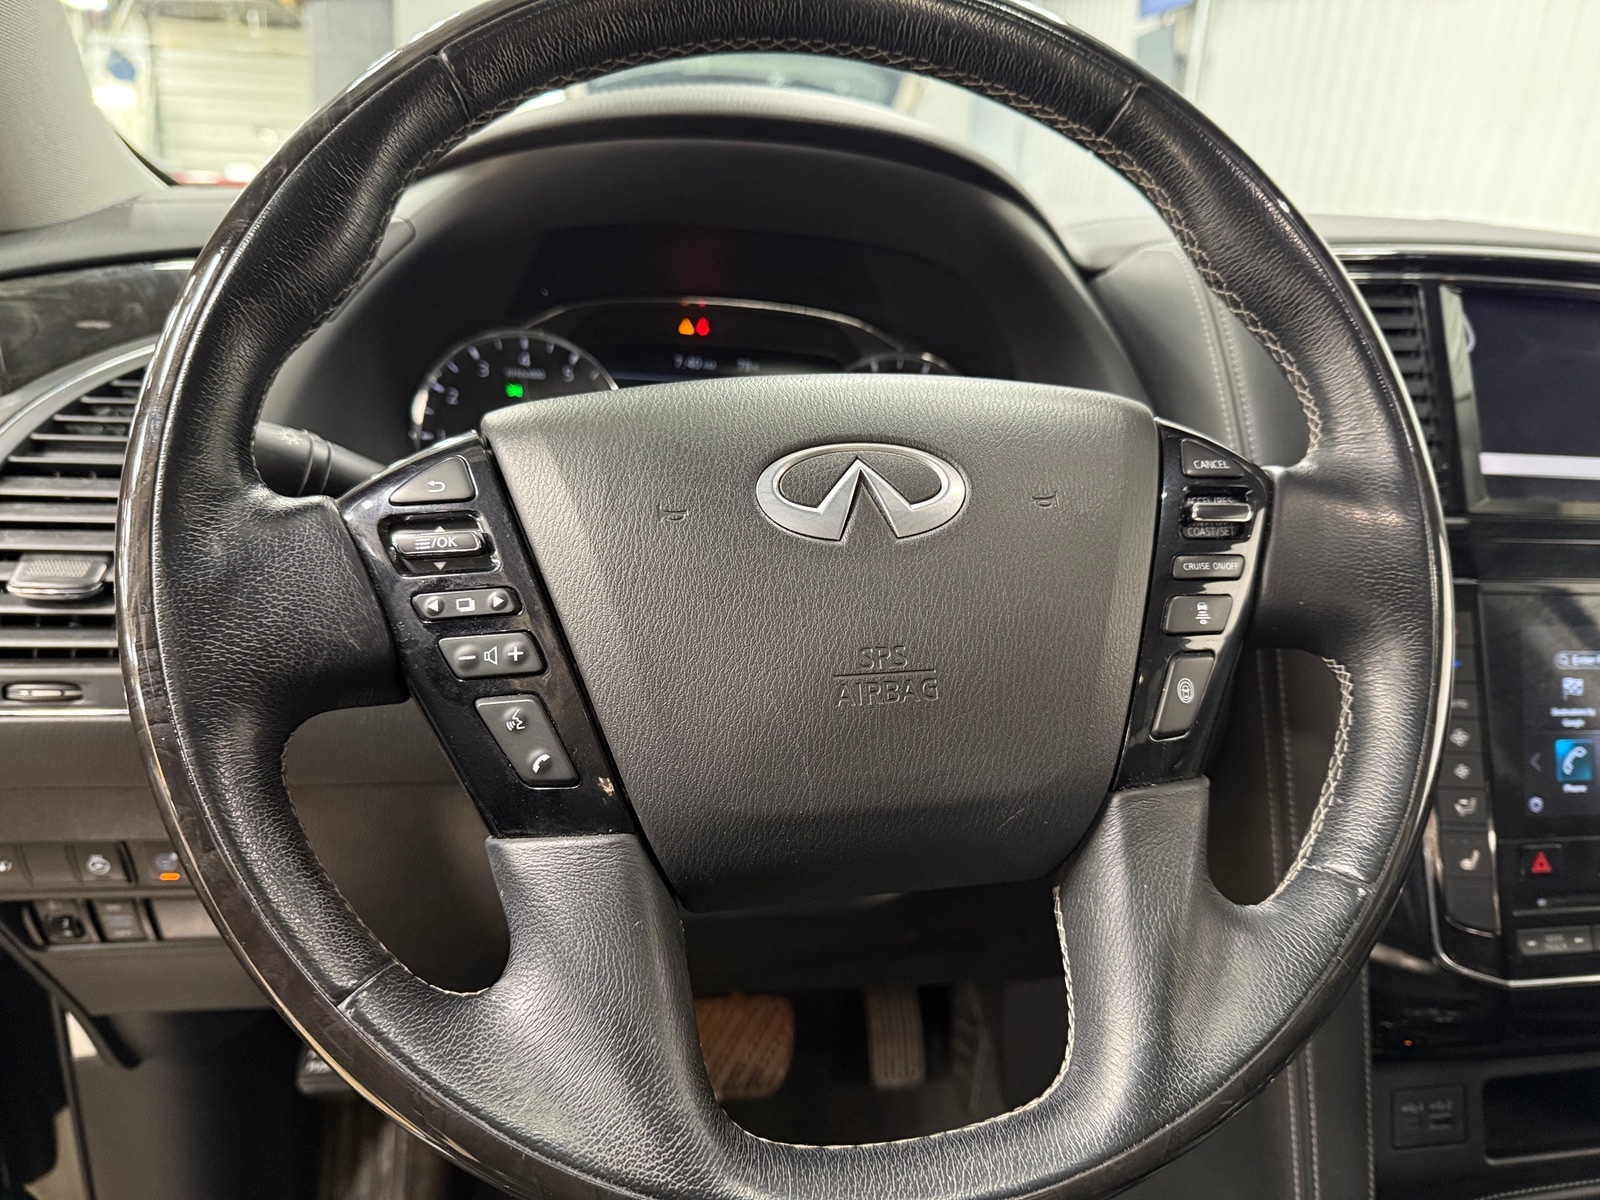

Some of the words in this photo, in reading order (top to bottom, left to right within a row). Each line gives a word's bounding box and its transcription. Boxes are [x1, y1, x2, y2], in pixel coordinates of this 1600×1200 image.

[473, 360, 490, 378] 3
[445, 387, 459, 405] 2
[1193, 460, 1231, 470] CANCEL
[1187, 526, 1235, 537] COAST/SET
[1183, 562, 1211, 571] CRUISE
[1212, 562, 1239, 571] ON/OFF
[860, 645, 908, 669] SRS
[836, 678, 939, 706] AIRBAG
